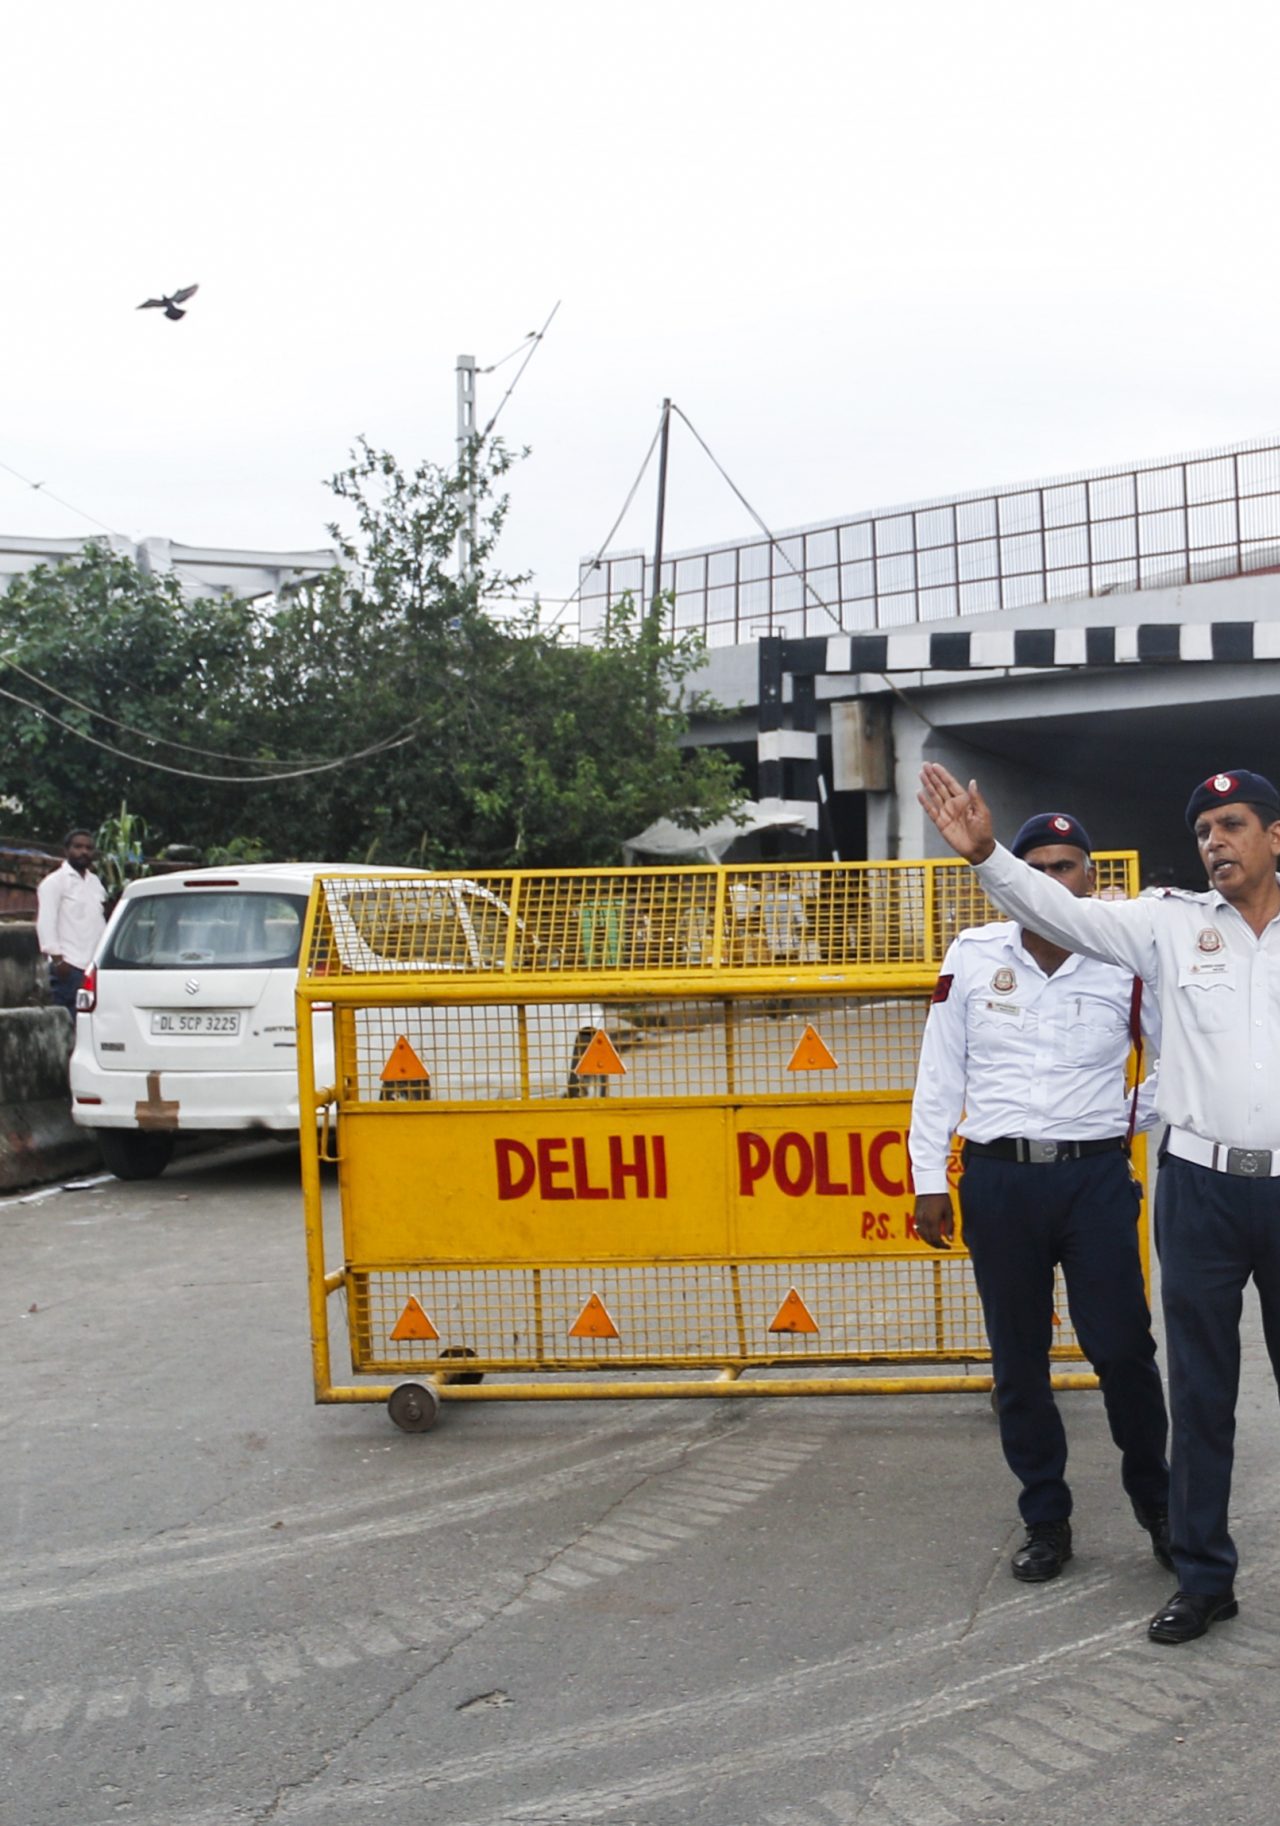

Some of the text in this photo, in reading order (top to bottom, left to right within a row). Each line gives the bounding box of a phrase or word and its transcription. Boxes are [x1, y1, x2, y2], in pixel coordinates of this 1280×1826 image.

[160, 1016, 237, 1031] DL 5CP 3225
[494, 1134, 668, 1201] DELHI
